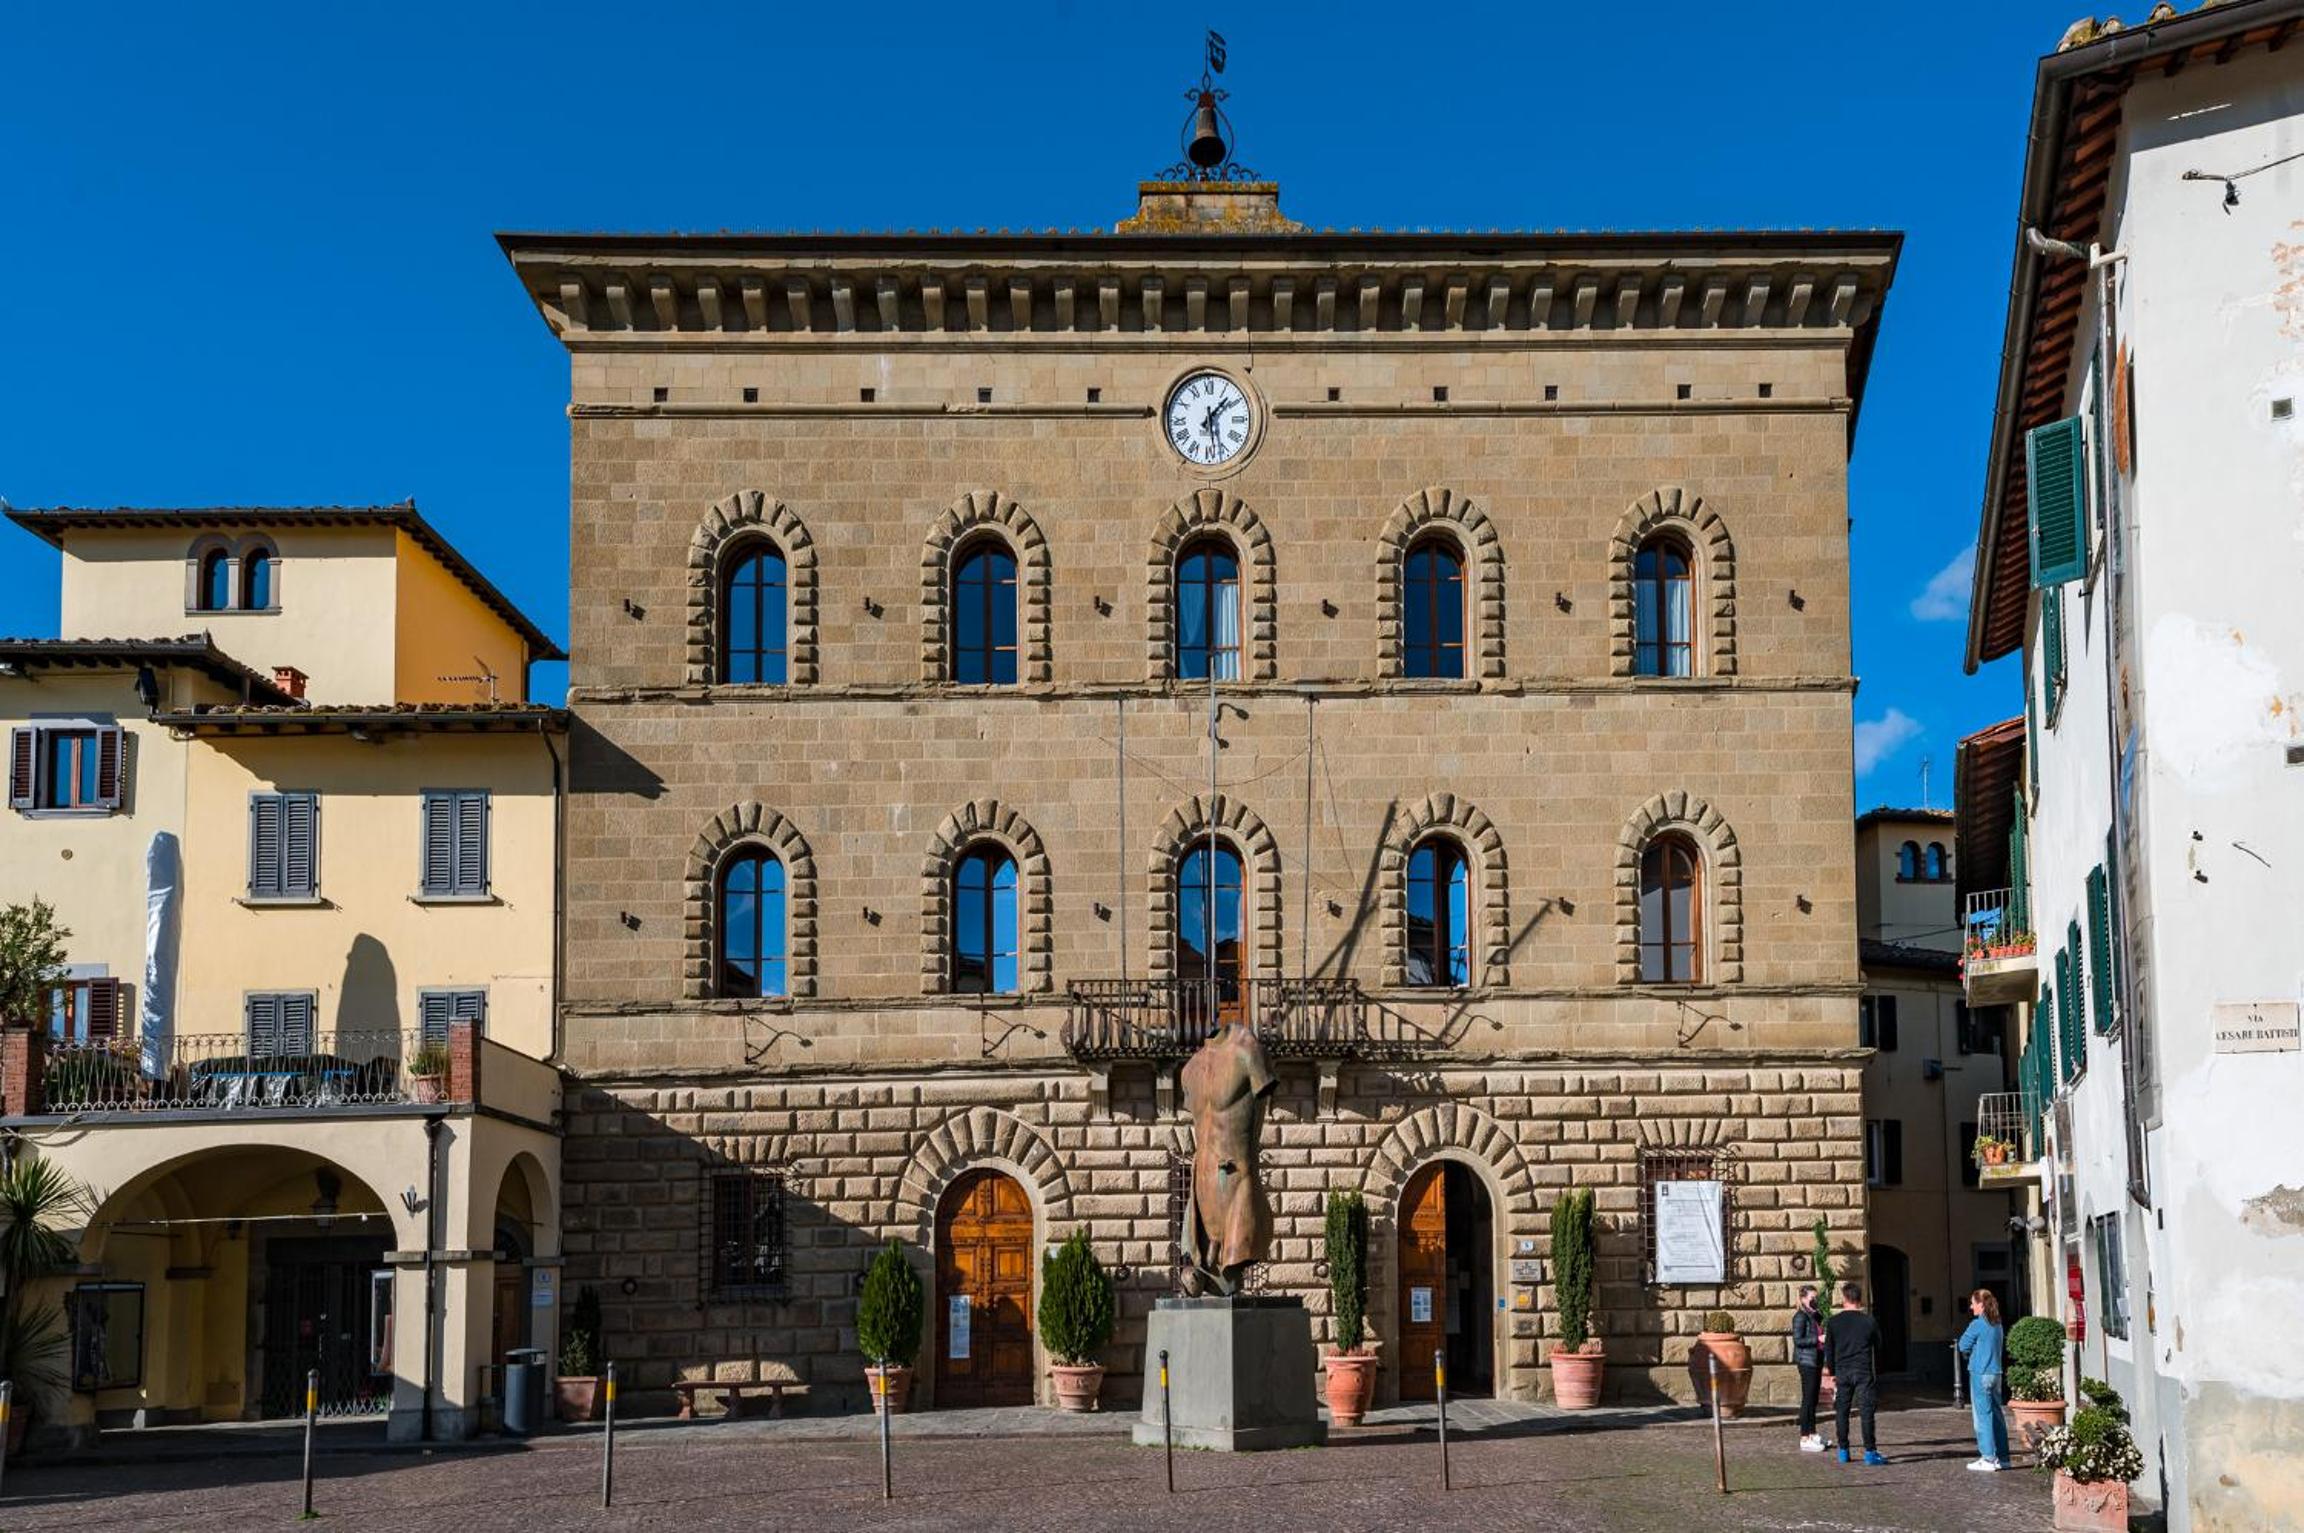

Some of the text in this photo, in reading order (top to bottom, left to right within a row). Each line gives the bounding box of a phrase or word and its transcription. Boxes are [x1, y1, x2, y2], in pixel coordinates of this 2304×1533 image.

[2248, 1015, 2263, 1023] VIA
[2216, 1029, 2298, 1040] CESARE BATTISTI
